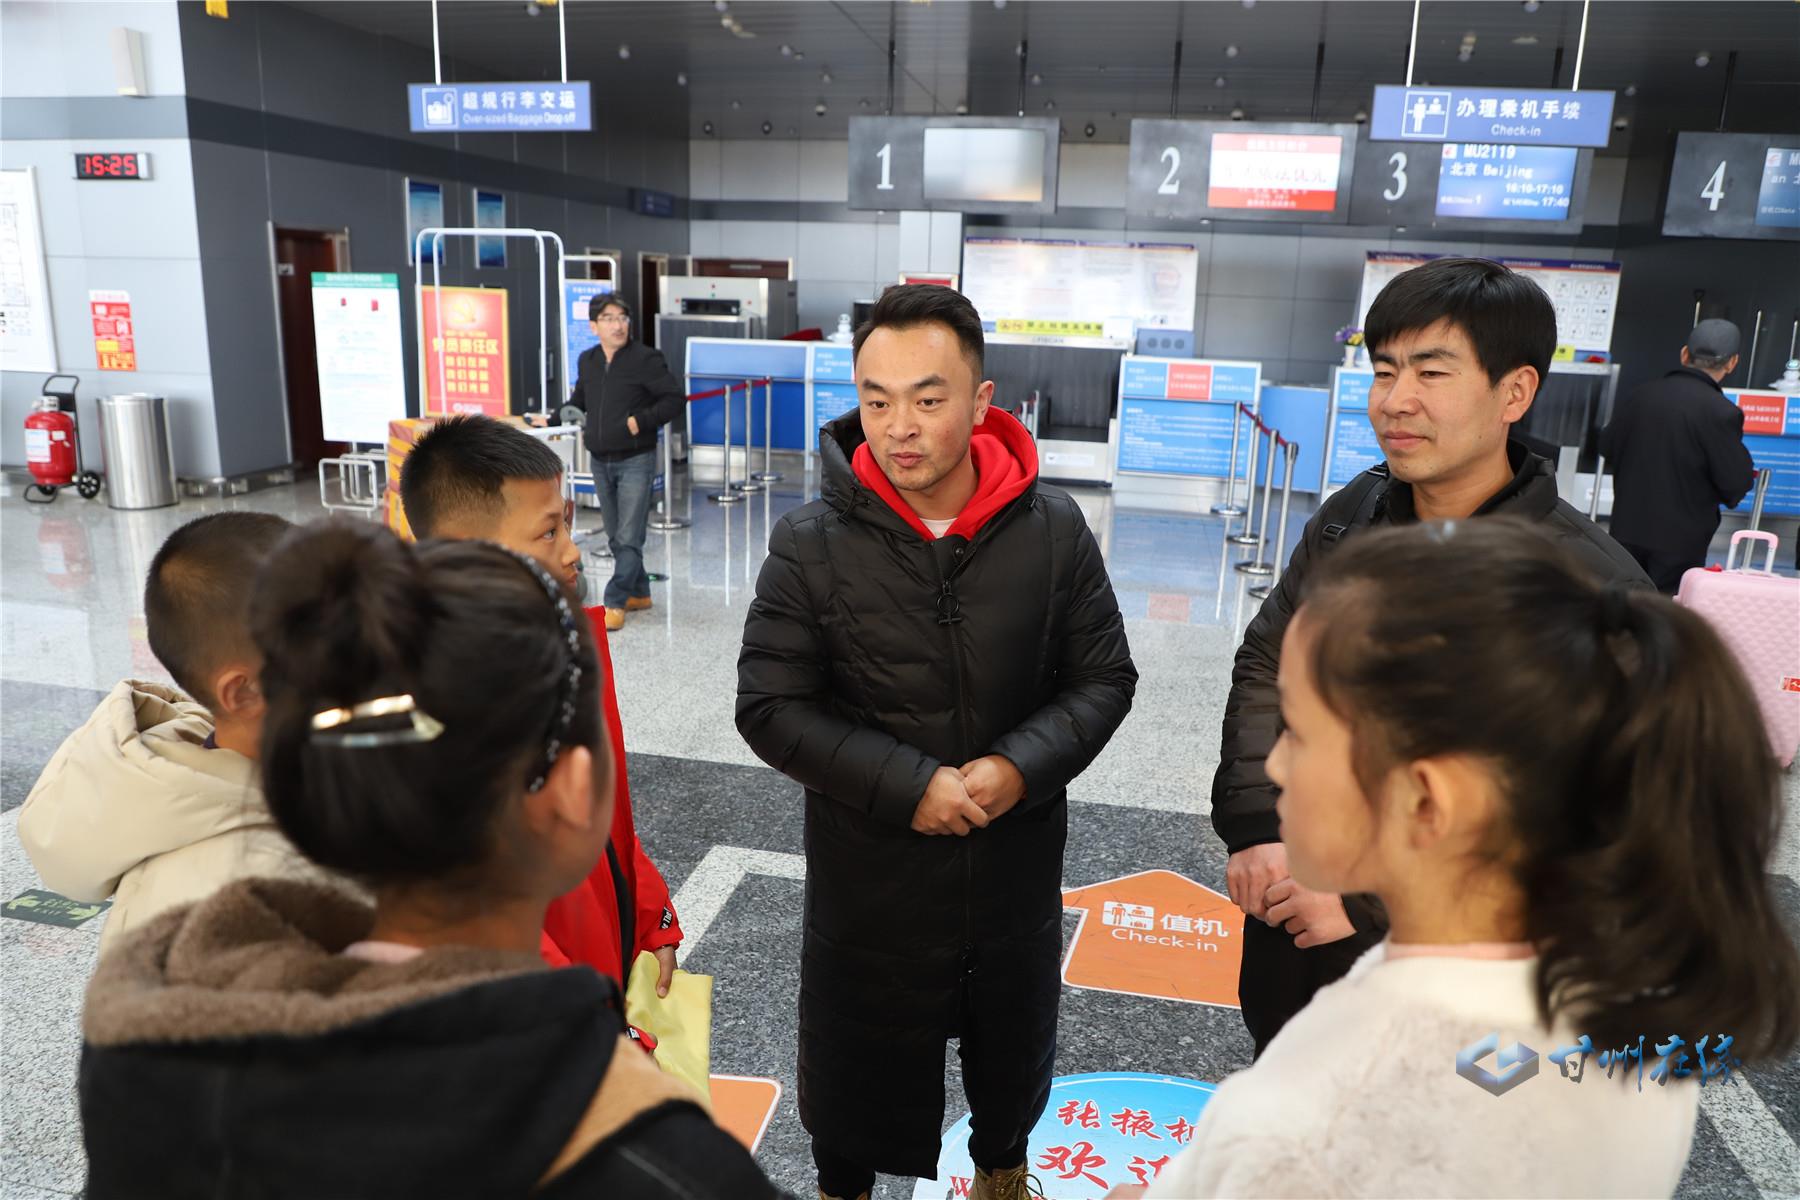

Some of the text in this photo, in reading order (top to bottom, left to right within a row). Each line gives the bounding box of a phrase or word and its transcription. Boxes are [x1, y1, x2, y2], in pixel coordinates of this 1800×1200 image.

[462, 90, 576, 110] 超规行李交运
[1455, 97, 1582, 120] 办理乘机手续
[1490, 123, 1542, 137] Check-in
[1463, 144, 1517, 160] MU2119
[84, 154, 137, 176] 15:25
[876, 143, 894, 190] 1
[1157, 146, 1181, 195] 2
[1383, 151, 1408, 202] 3
[1450, 162, 1534, 180] 北京 Beijing
[1700, 160, 1727, 212] 4
[1160, 912, 1230, 938] 值机
[1111, 927, 1219, 953] Check-in
